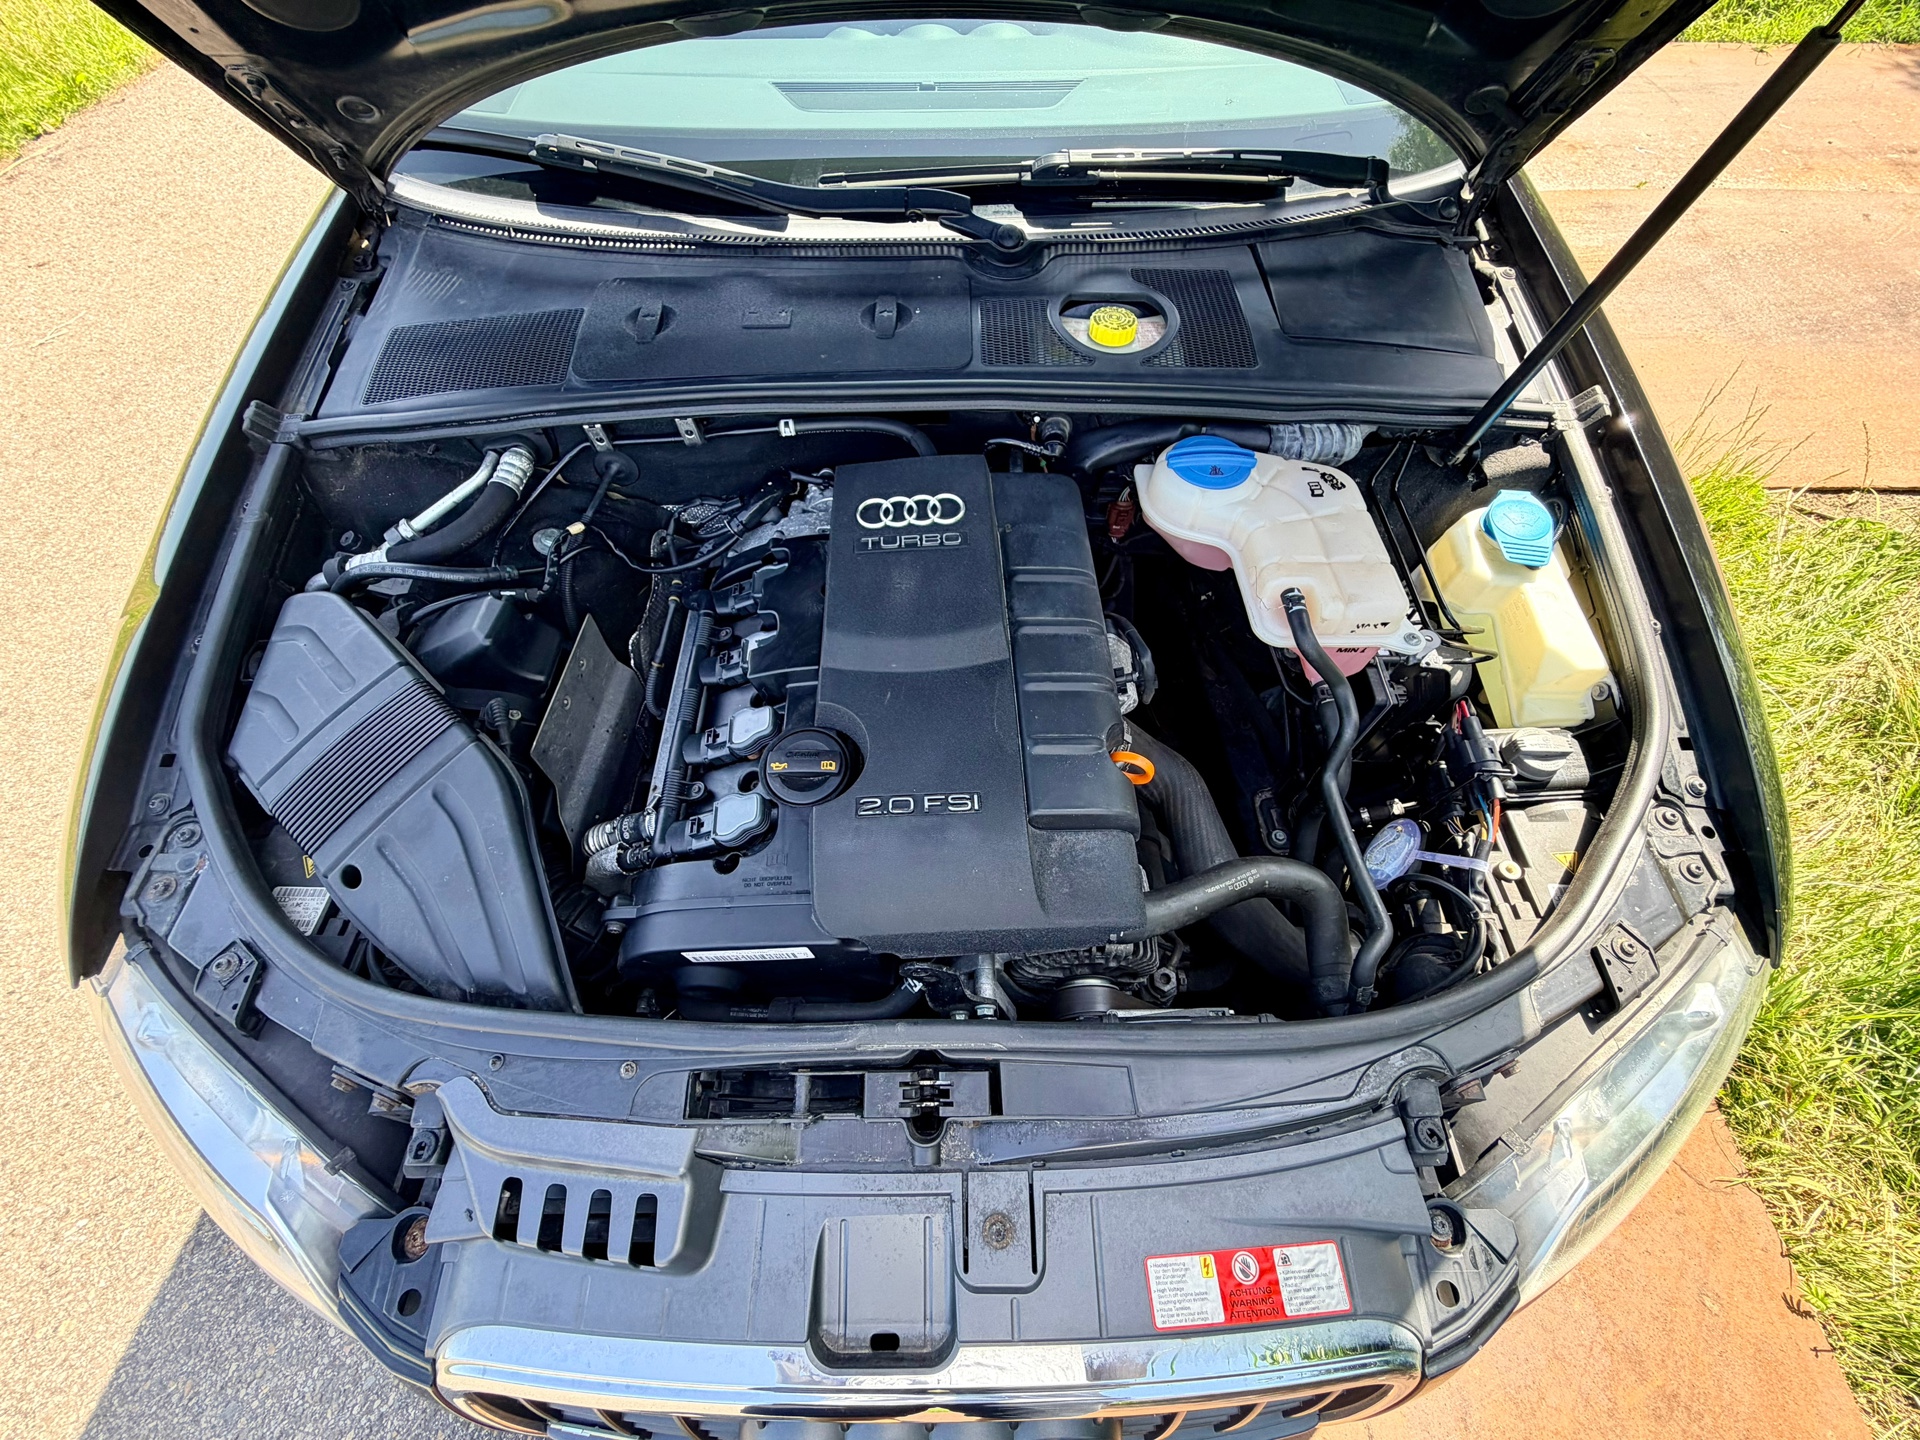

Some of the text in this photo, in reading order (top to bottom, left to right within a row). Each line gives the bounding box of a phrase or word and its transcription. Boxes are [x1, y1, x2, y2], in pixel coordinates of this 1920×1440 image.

[861, 532, 962, 550] TURBO
[857, 794, 979, 816] 2.0 FSI
[1229, 1286, 1272, 1297] ACHTUNG
[1230, 1297, 1274, 1308] WARNING
[1230, 1307, 1279, 1319] ATTENTION
